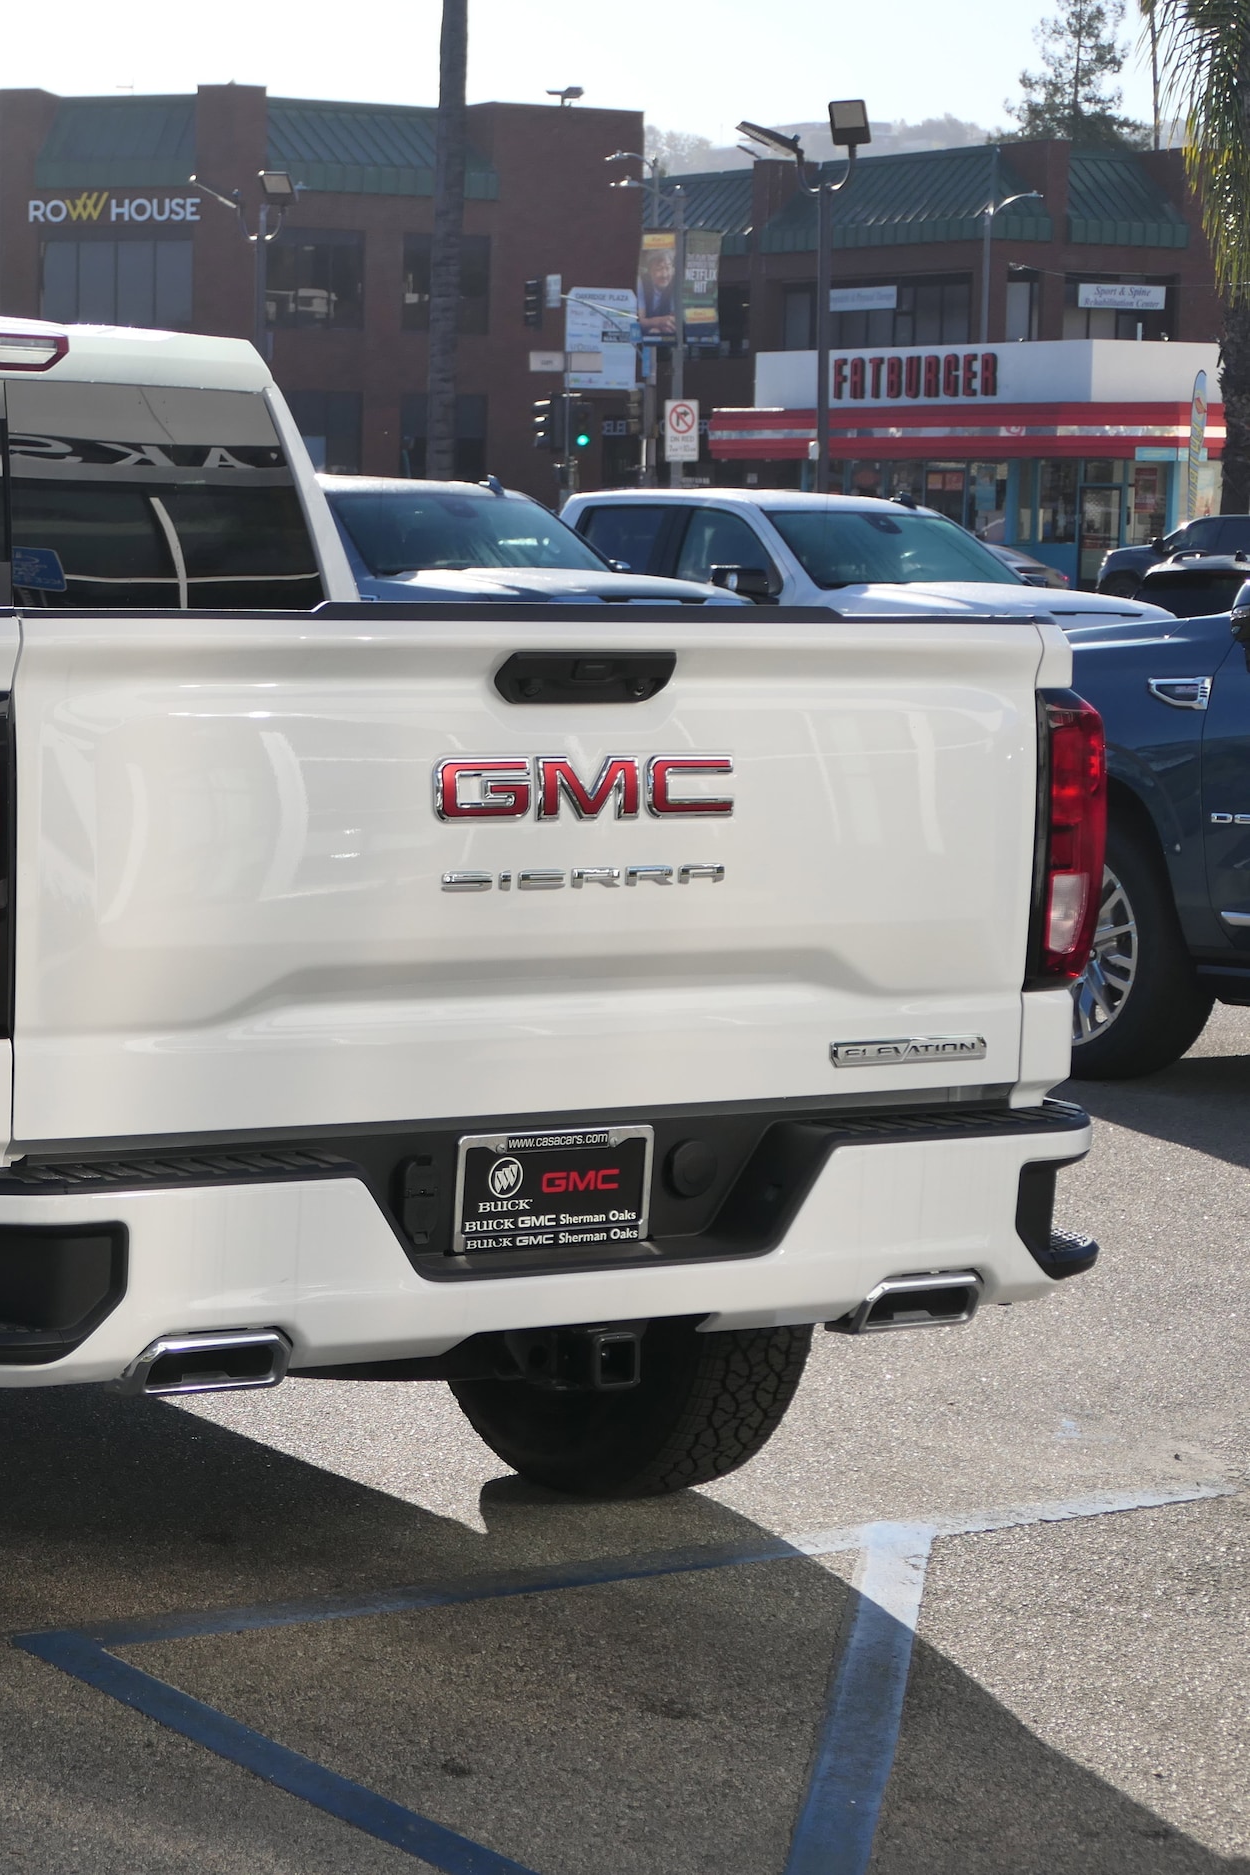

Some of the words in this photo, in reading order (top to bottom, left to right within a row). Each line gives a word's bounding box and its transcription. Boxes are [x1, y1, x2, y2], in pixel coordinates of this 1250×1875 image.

[111, 198, 201, 222] HOUSE
[685, 268, 717, 281] NETFLIX
[694, 281, 707, 293] HIT
[1094, 286, 1117, 297] Sport
[1119, 286, 1126, 296] &
[1129, 287, 1152, 298] Spine
[574, 293, 606, 301] OAKRIDGE
[1136, 299, 1160, 308] Center
[833, 352, 998, 400] FATBURGER
[433, 754, 734, 823] GMC
[441, 863, 726, 891] SIERRA
[844, 1042, 976, 1058] ELEVATION
[508, 1132, 608, 1149] www.casacars.com
[541, 1169, 620, 1193] GMC
[478, 1199, 530, 1213] BUICK
[465, 1218, 515, 1233] BUICK
[518, 1214, 556, 1228] GMC
[559, 1212, 606, 1226] Sherman
[609, 1210, 637, 1222] Oaks
[466, 1237, 512, 1250] BUICK
[516, 1234, 554, 1246] GMC
[558, 1231, 607, 1244] Sherman
[610, 1228, 638, 1240] Oaks
